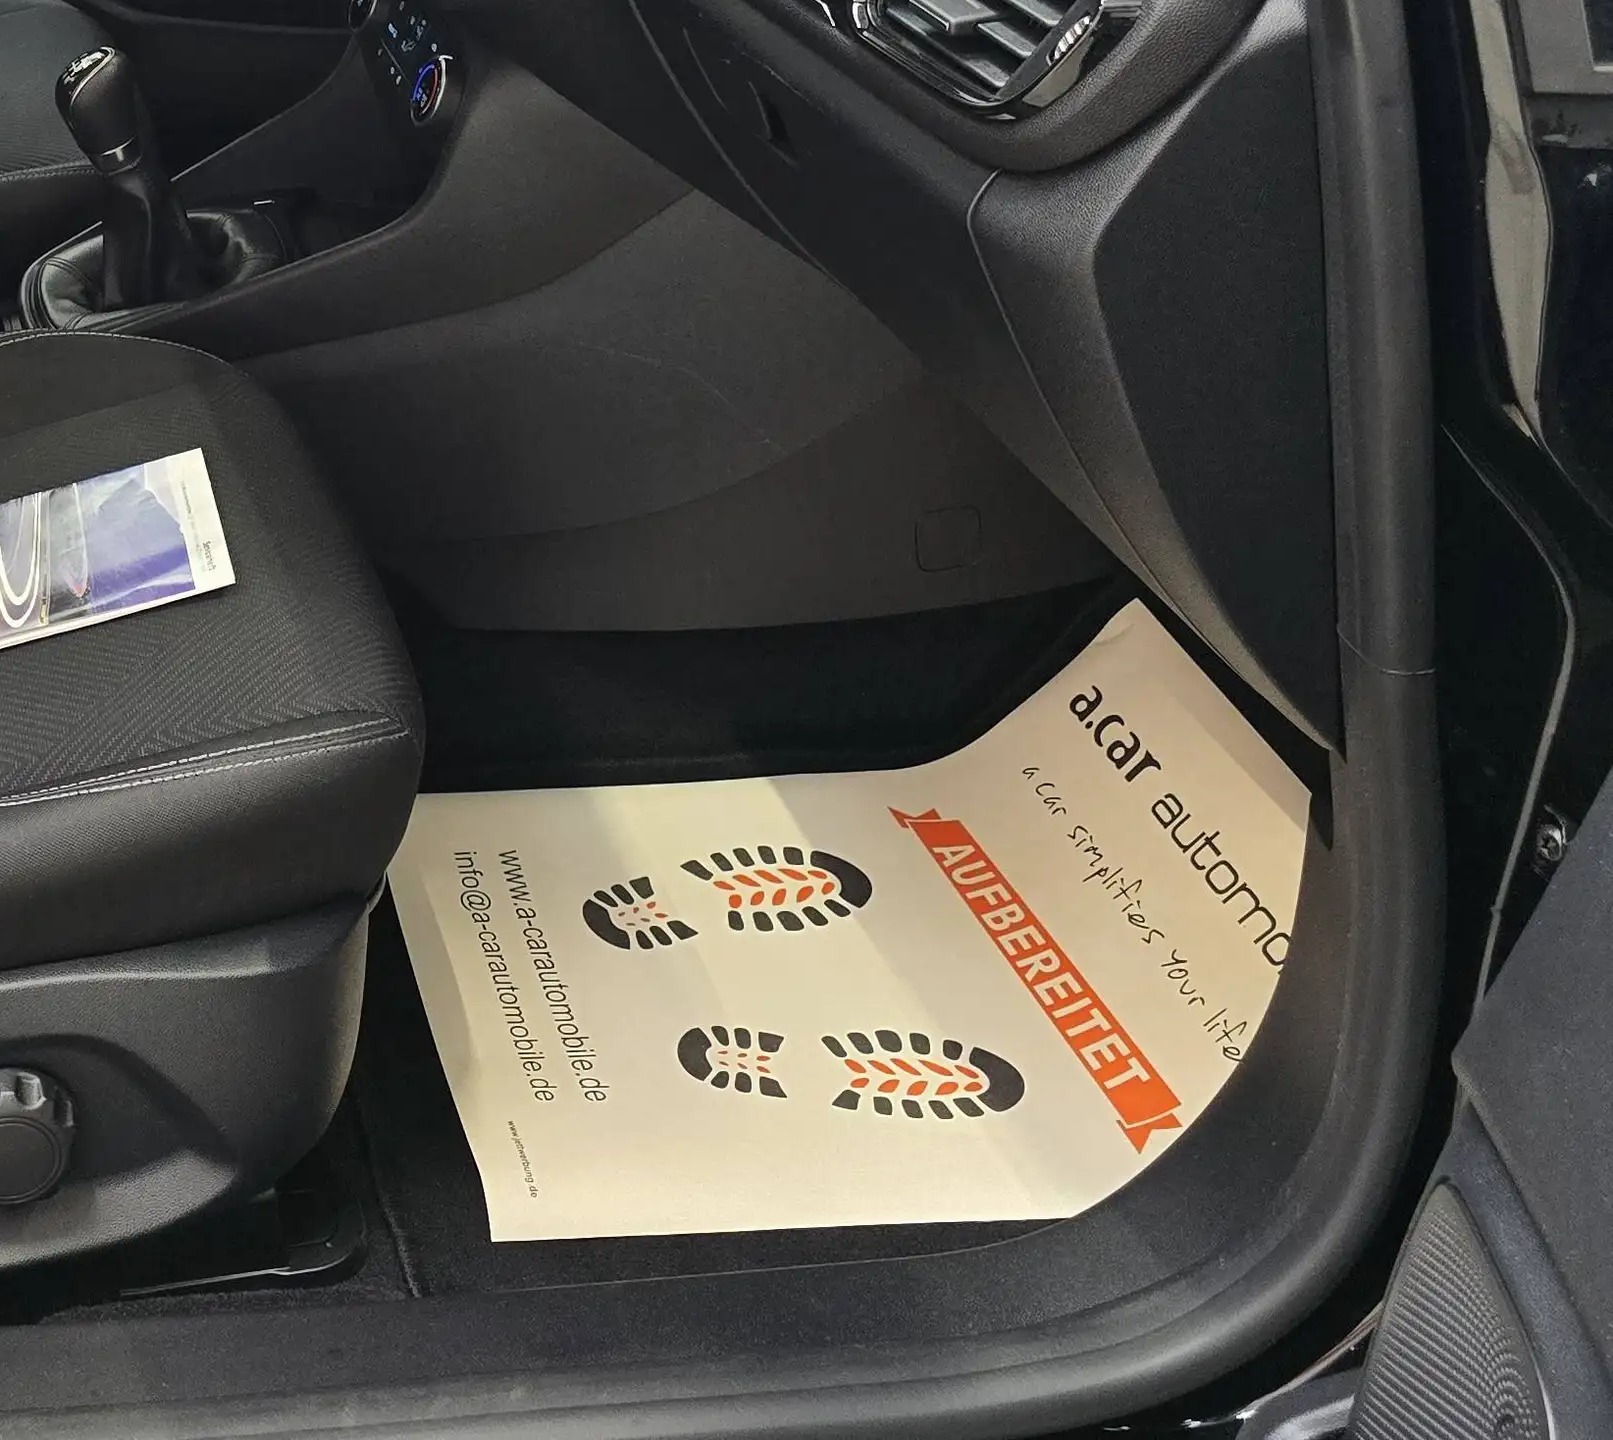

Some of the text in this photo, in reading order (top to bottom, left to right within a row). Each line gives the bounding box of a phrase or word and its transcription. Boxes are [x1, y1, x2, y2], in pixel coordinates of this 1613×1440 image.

[1036, 783, 1067, 816] car
[1068, 826, 1165, 944] simplifies
[1161, 949, 1205, 1007] your
[1203, 1009, 1248, 1061] life
[1069, 685, 1292, 974] a.car automo
[454, 851, 555, 1102] info@a-carautomobile.de
[499, 850, 609, 1102] www.a-carautomobile.de
[932, 844, 1151, 1090] AUFBEREITET
